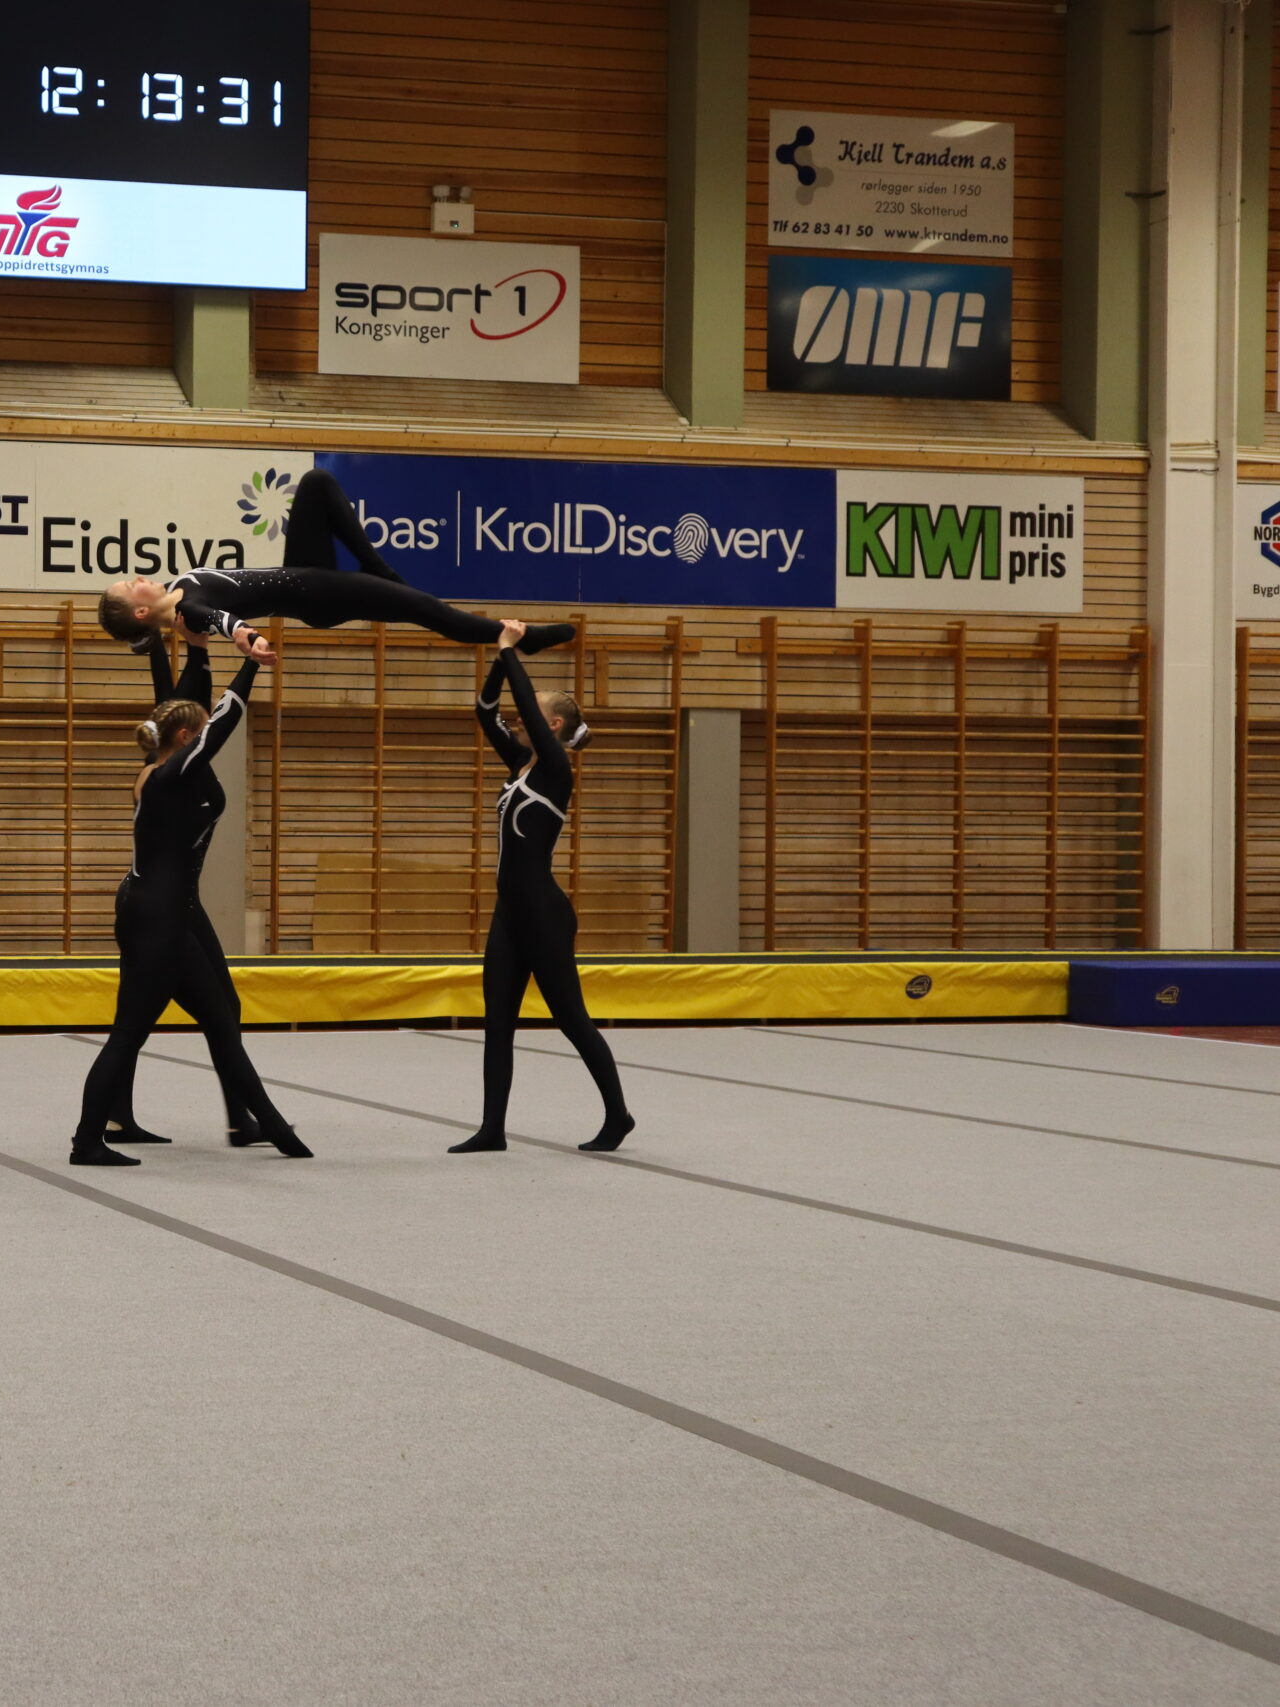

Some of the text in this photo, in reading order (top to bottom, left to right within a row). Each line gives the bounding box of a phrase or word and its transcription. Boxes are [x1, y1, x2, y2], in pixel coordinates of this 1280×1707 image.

[838, 140, 1007, 171] Kjell Trandem a.s
[861, 178, 982, 196] rørlegger siden 1950
[875, 200, 968, 217] 2230 Skotterud
[773, 219, 1009, 244] Tlf 62 83 41 50 www.ktrandem.no
[335, 282, 526, 317] sport 1
[336, 315, 450, 343] Kongsvinger
[1010, 503, 1074, 538] mini
[42, 516, 245, 576] Eidsiva
[846, 501, 1001, 580] KIWI
[1009, 543, 1066, 584] pris
